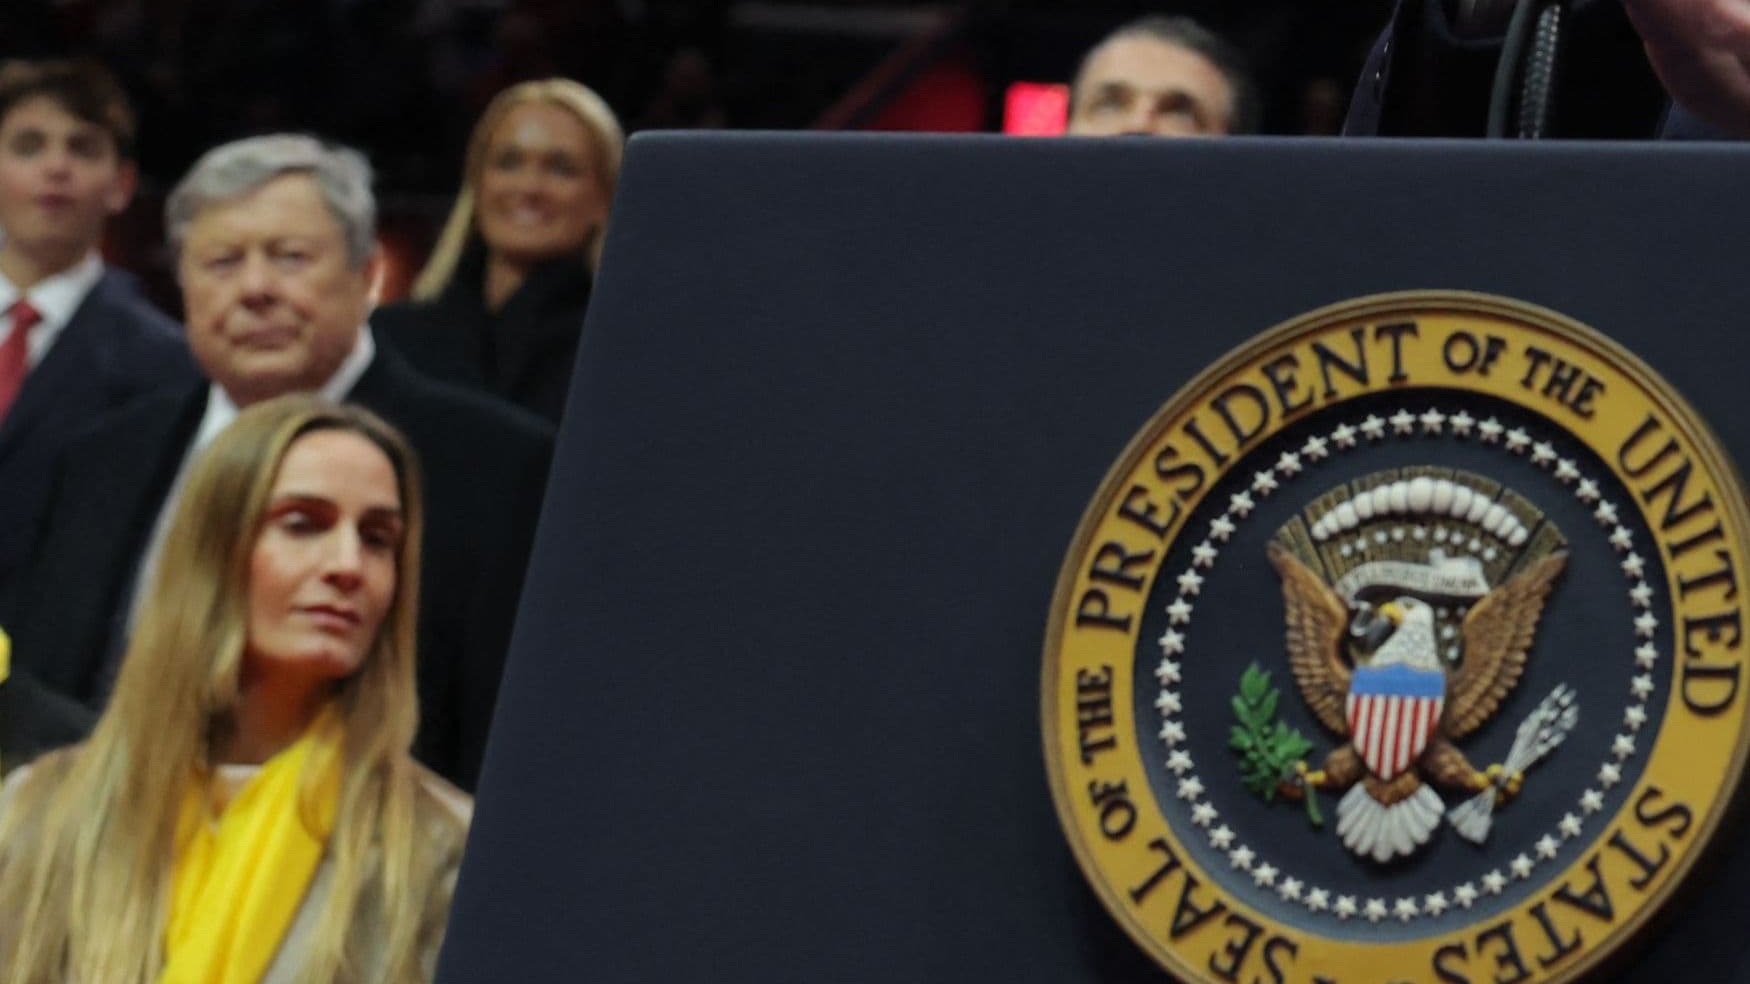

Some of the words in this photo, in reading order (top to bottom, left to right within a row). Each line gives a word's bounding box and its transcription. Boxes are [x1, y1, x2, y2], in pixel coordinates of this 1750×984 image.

[1442, 330, 1507, 376] OF
[1520, 345, 1606, 418] THE
[1075, 321, 1419, 635] PRESIDENT
[1617, 413, 1742, 716] UNITED
[1076, 664, 1118, 766] THE
[1088, 777, 1138, 843] OF
[1129, 837, 1299, 984] SEAL
[1431, 786, 1692, 984] STATES
